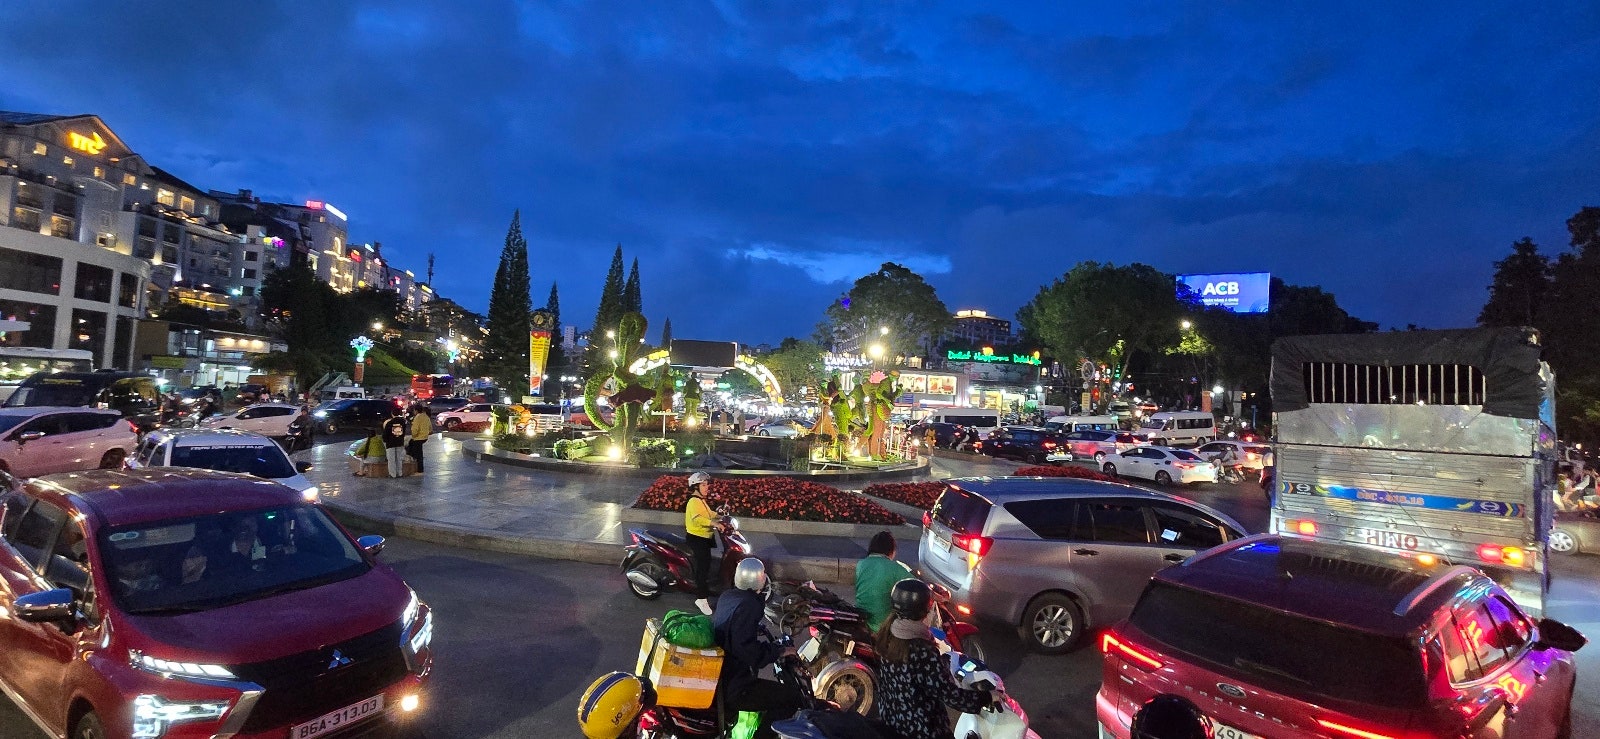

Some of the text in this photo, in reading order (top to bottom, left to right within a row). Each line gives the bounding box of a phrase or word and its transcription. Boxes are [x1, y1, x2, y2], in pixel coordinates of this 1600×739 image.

[1203, 281, 1239, 295] ACB
[1365, 528, 1419, 550] HINO
[300, 699, 377, 738] 86A-313.03
